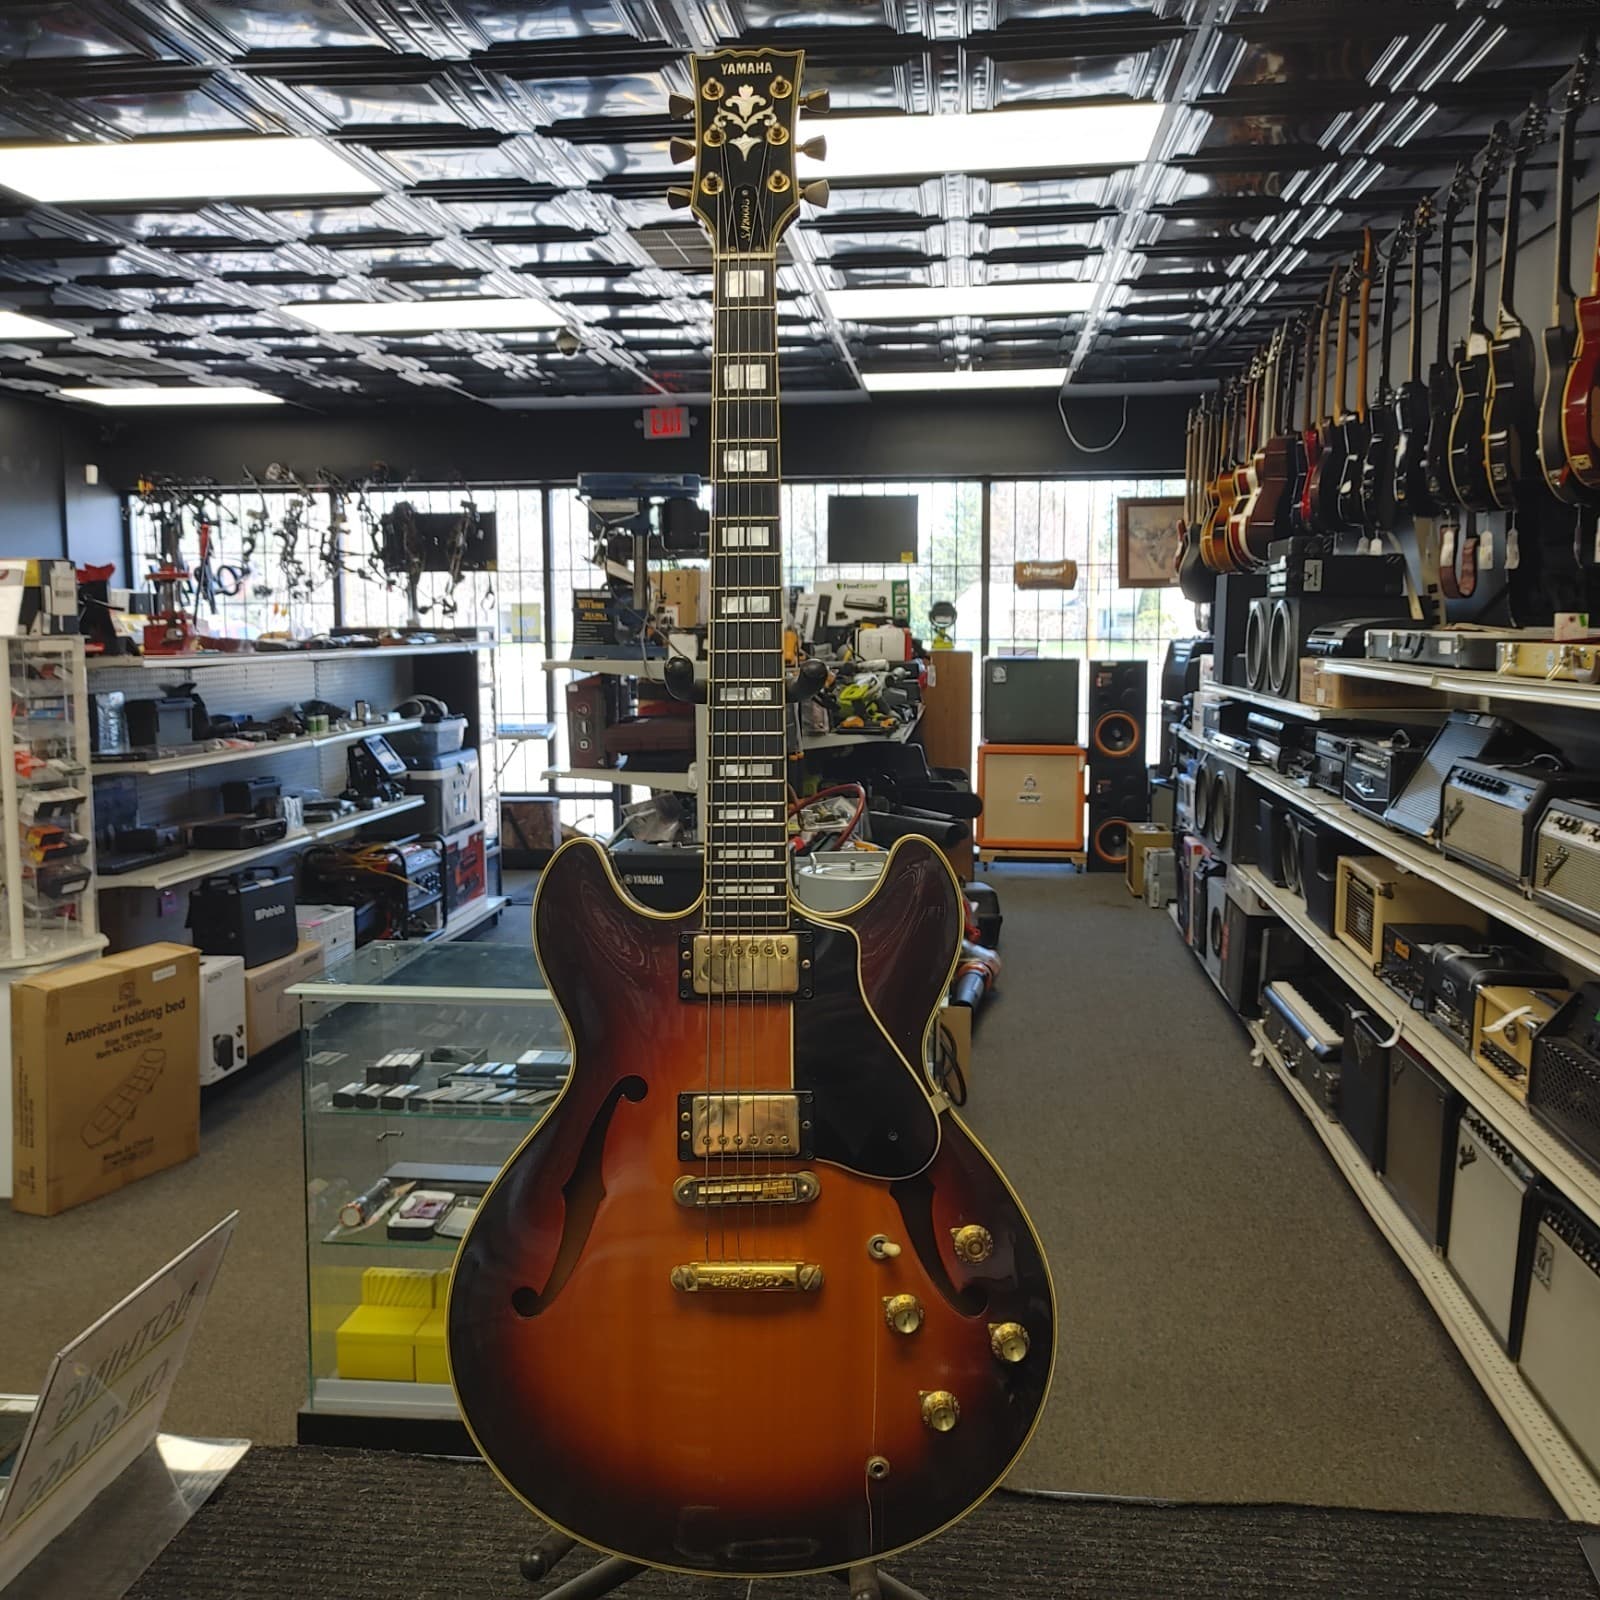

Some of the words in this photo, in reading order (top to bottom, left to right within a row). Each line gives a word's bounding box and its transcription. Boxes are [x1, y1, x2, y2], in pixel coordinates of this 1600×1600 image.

[721, 62, 773, 75] YAMAHA
[650, 408, 683, 435] EXIT
[633, 874, 664, 885] YAMAHA
[65, 1019, 121, 1046] American
[124, 1007, 162, 1027] folding
[165, 996, 186, 1014] bed
